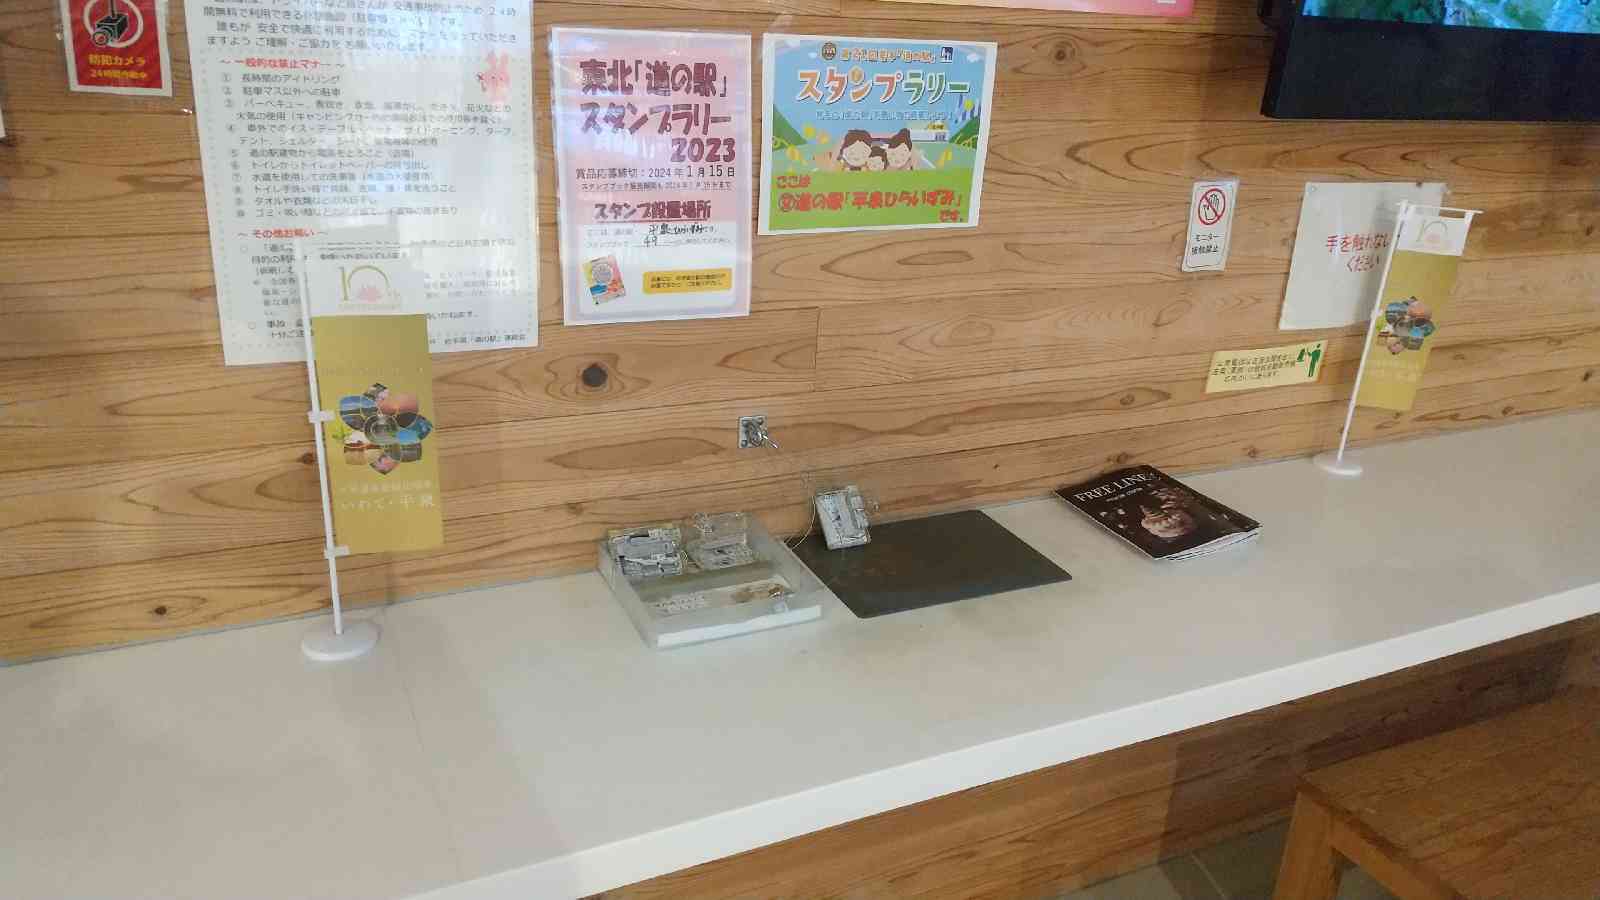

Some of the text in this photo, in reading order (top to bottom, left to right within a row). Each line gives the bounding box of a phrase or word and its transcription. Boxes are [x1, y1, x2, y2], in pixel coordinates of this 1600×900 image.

[88, 54, 146, 66] 防犯カメラ
[579, 58, 728, 98] 東北「道の駅」
[796, 66, 970, 105] スタンプラリー
[580, 101, 732, 135] スタンプラリー
[670, 137, 736, 163] 2023
[777, 175, 811, 189] ここは
[594, 200, 712, 219] スタンプ設置場所
[1192, 233, 1226, 242] モニター
[1346, 253, 1381, 273] ください
[1074, 484, 1115, 502] FREE
[1114, 473, 1150, 490] LINE
